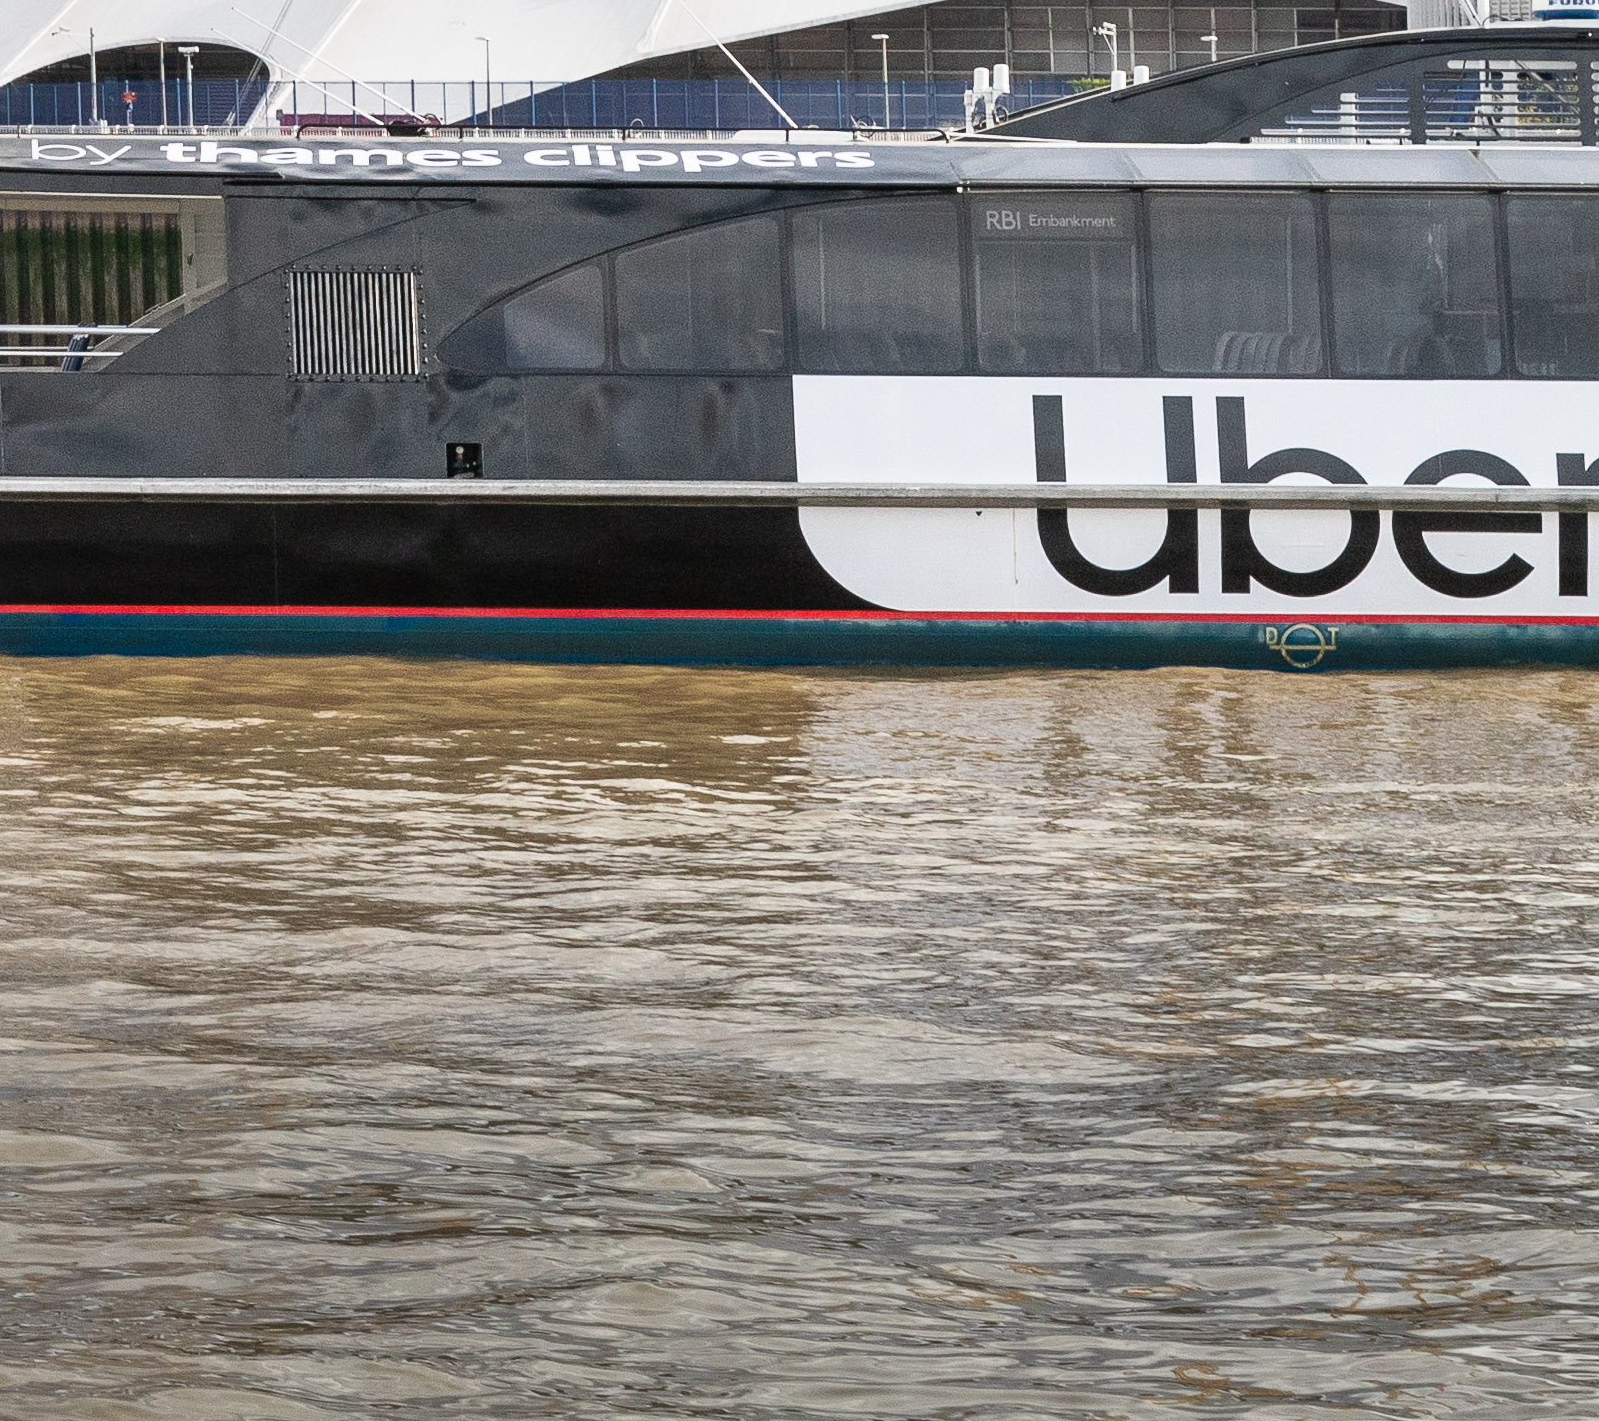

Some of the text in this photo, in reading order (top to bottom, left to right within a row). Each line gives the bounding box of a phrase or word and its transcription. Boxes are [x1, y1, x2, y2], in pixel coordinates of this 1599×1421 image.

[30, 139, 876, 173] by thames clippers
[1028, 214, 1116, 227] Embankment
